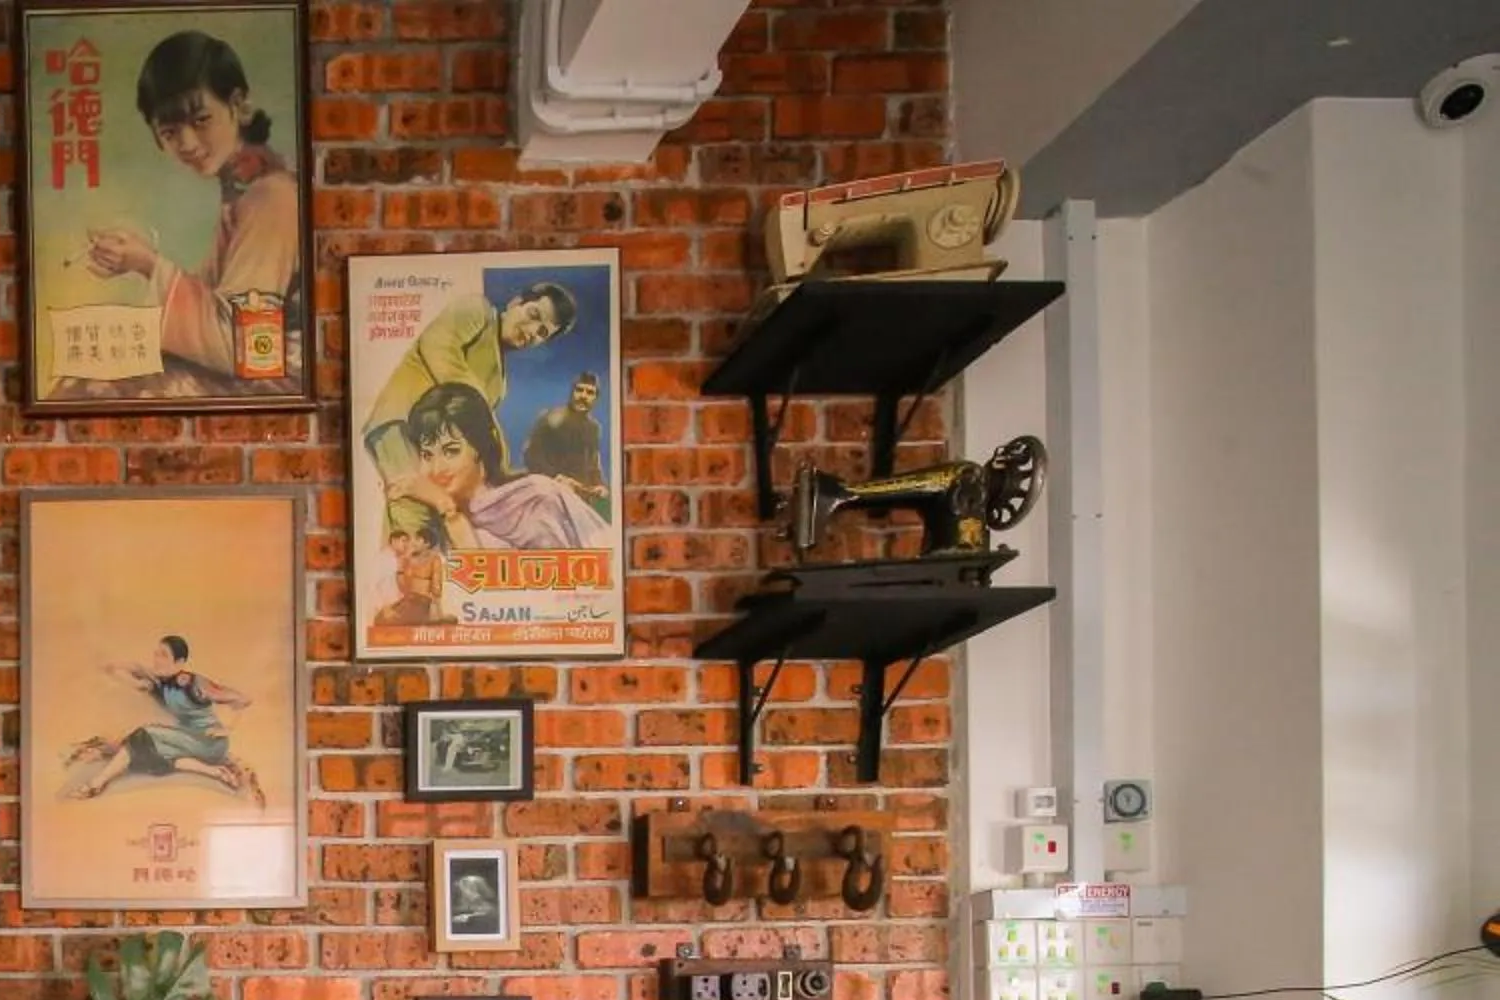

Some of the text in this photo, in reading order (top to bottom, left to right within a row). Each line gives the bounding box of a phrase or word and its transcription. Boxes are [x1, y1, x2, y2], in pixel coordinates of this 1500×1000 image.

[46, 37, 102, 190] 哈德門
[447, 548, 615, 594] साजन
[462, 601, 531, 622] SAJAN
